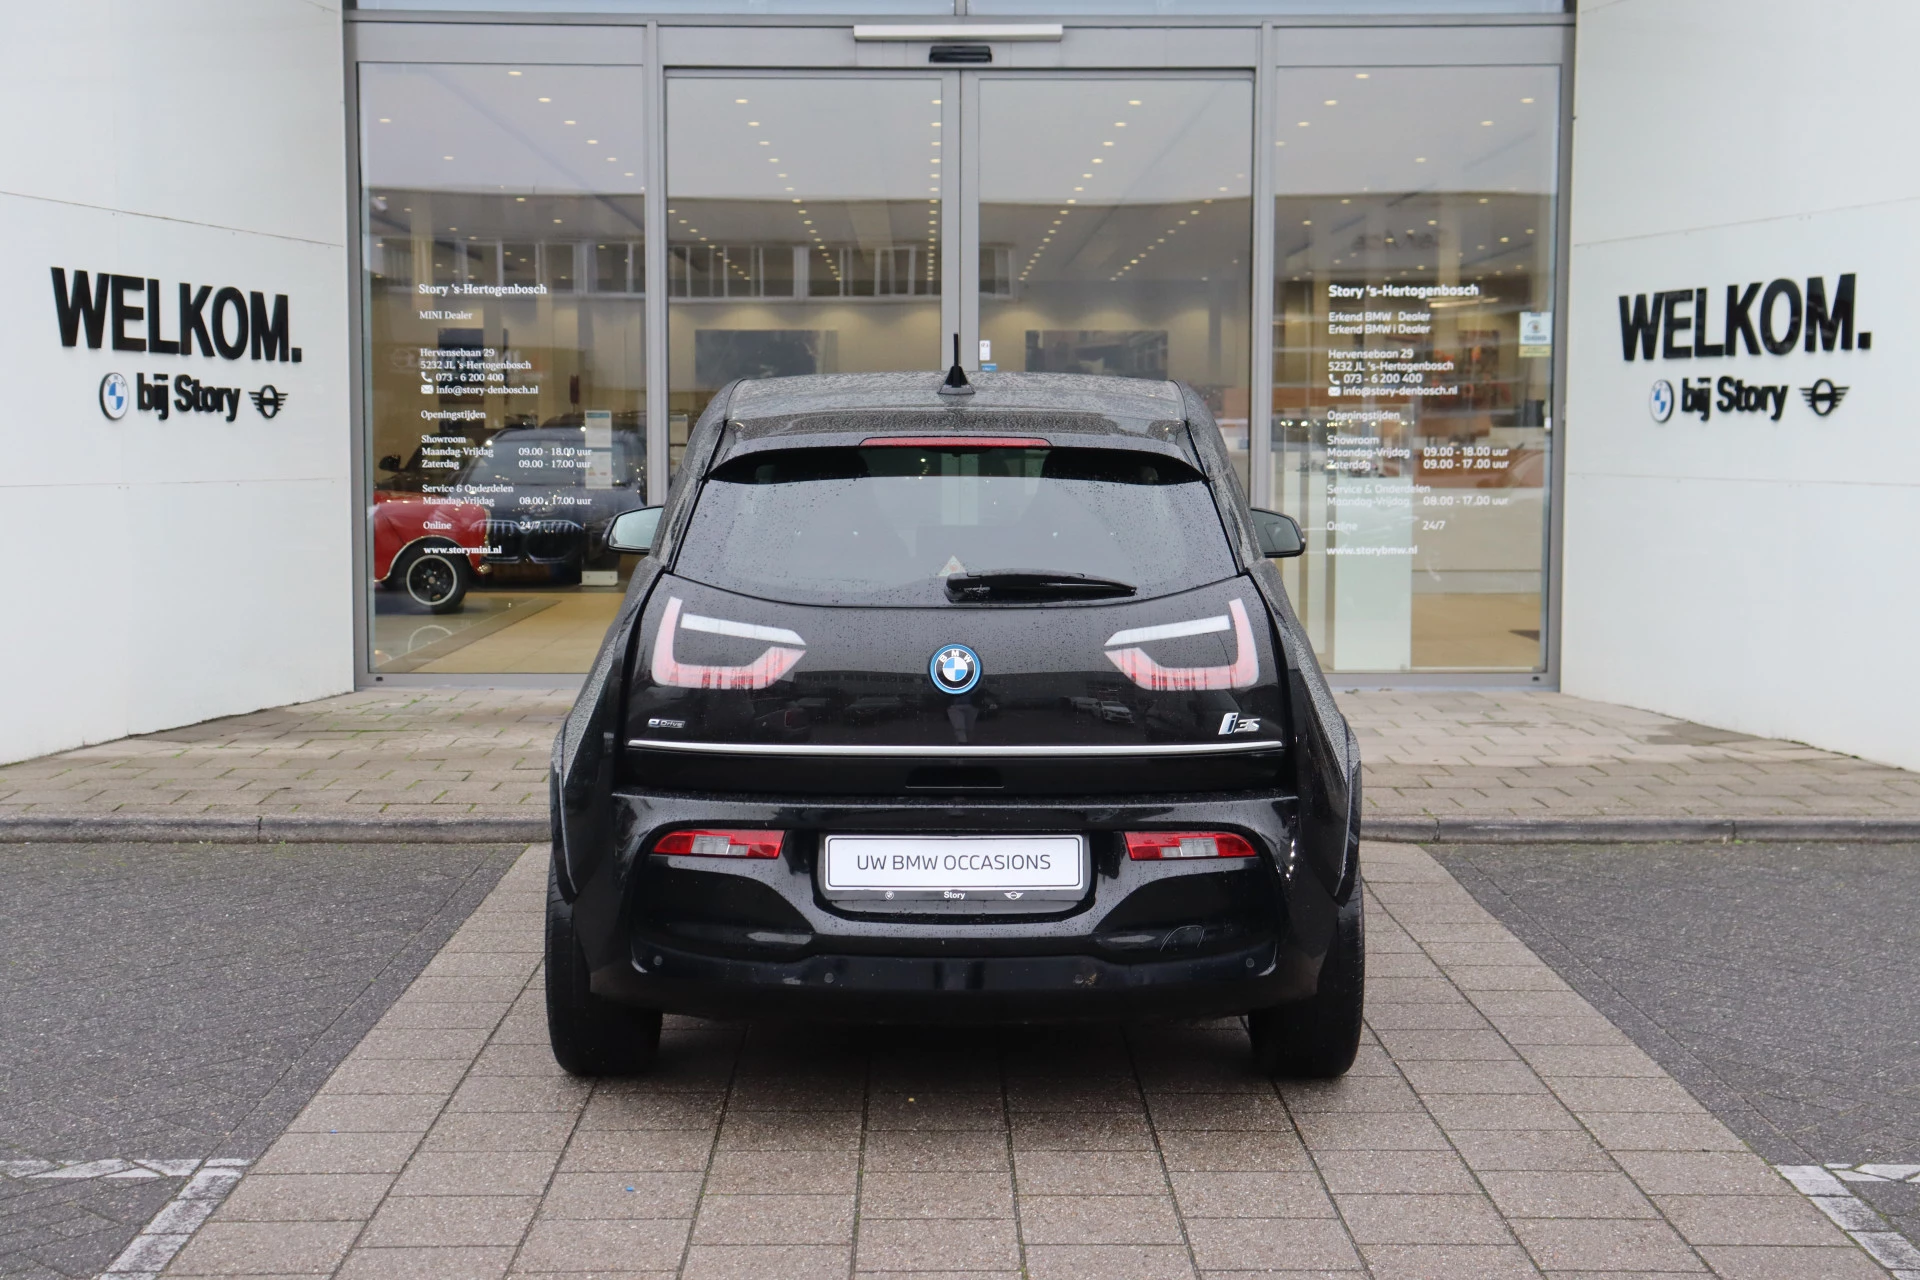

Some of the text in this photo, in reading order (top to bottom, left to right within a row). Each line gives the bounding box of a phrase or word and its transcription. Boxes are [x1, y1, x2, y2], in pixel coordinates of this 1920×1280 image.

[418, 283, 548, 297] Story 's-Hertogenbosch
[1328, 283, 1479, 299] Story 's-Hertogenbosch
[51, 266, 302, 362] WELKOM.
[419, 310, 473, 320] MINI Dealer
[1328, 312, 1431, 322] Erkend BMW Dealer
[1618, 272, 1872, 361] WELKOM.
[1328, 324, 1363, 334] Erkend
[1365, 325, 1391, 334] BMW
[1398, 324, 1431, 334] Dealer
[420, 348, 481, 357] Hervensebaan
[483, 348, 495, 357] 29
[1328, 348, 1414, 359] Hervensebaan 29
[420, 360, 532, 371] 5232 JL 's-Hertogenbosch
[1328, 362, 1454, 373] 5232 JL 's-Hertogenbosch
[436, 372, 453, 382] 073
[460, 372, 467, 382] 6
[468, 372, 485, 382] 200
[487, 372, 504, 382] 400
[1343, 374, 1362, 383] 073
[1371, 374, 1378, 383] 6
[1380, 374, 1400, 383] 200
[1402, 374, 1423, 383] 400
[436, 385, 539, 396] info@story-denbosch.nl
[1343, 386, 1458, 397] info@story-denbosch.nl
[137, 372, 240, 422] bij Story
[1681, 375, 1788, 422] bij Story
[420, 410, 487, 422] Openingstijden
[1327, 410, 1400, 422] Openingstijden
[421, 435, 467, 444] Showroom
[1327, 435, 1380, 445] Showroom
[422, 447, 494, 458] Maandag-Vrijdag
[518, 448, 543, 456] 09.00
[551, 447, 575, 456] 18.00
[1327, 447, 1411, 459] Maandag-Vrijdag
[1423, 447, 1454, 457] 09.00
[1462, 446, 1491, 457] 18.00
[1492, 448, 1509, 456] uur
[422, 459, 460, 470] Zaterdag
[518, 460, 543, 469] 09.00
[551, 460, 575, 469] 17.00
[1327, 459, 1371, 470] Zaterdag
[1423, 459, 1454, 469] 09.00
[1462, 459, 1491, 469] 17.00
[1492, 461, 1510, 469] uur
[422, 484, 514, 493] Service & Onderdelen
[1327, 484, 1431, 494] Service & Onderdelen
[423, 496, 495, 507] Maandag-Vrijdag
[552, 496, 575, 506] 17.00
[576, 498, 592, 506] uur
[1327, 496, 1410, 507] Maandag-Vrijdag
[1423, 496, 1454, 506] 08.00
[423, 521, 541, 532] Online 24/7
[1327, 520, 1446, 531] Online 24/7
[423, 545, 503, 556] www.storymini.nl
[1326, 545, 1418, 556] www.storybmw.nl
[938, 649, 973, 663] BMW
[857, 854, 1051, 870] UW BMW OCCASIONS
[943, 891, 966, 900] Story
